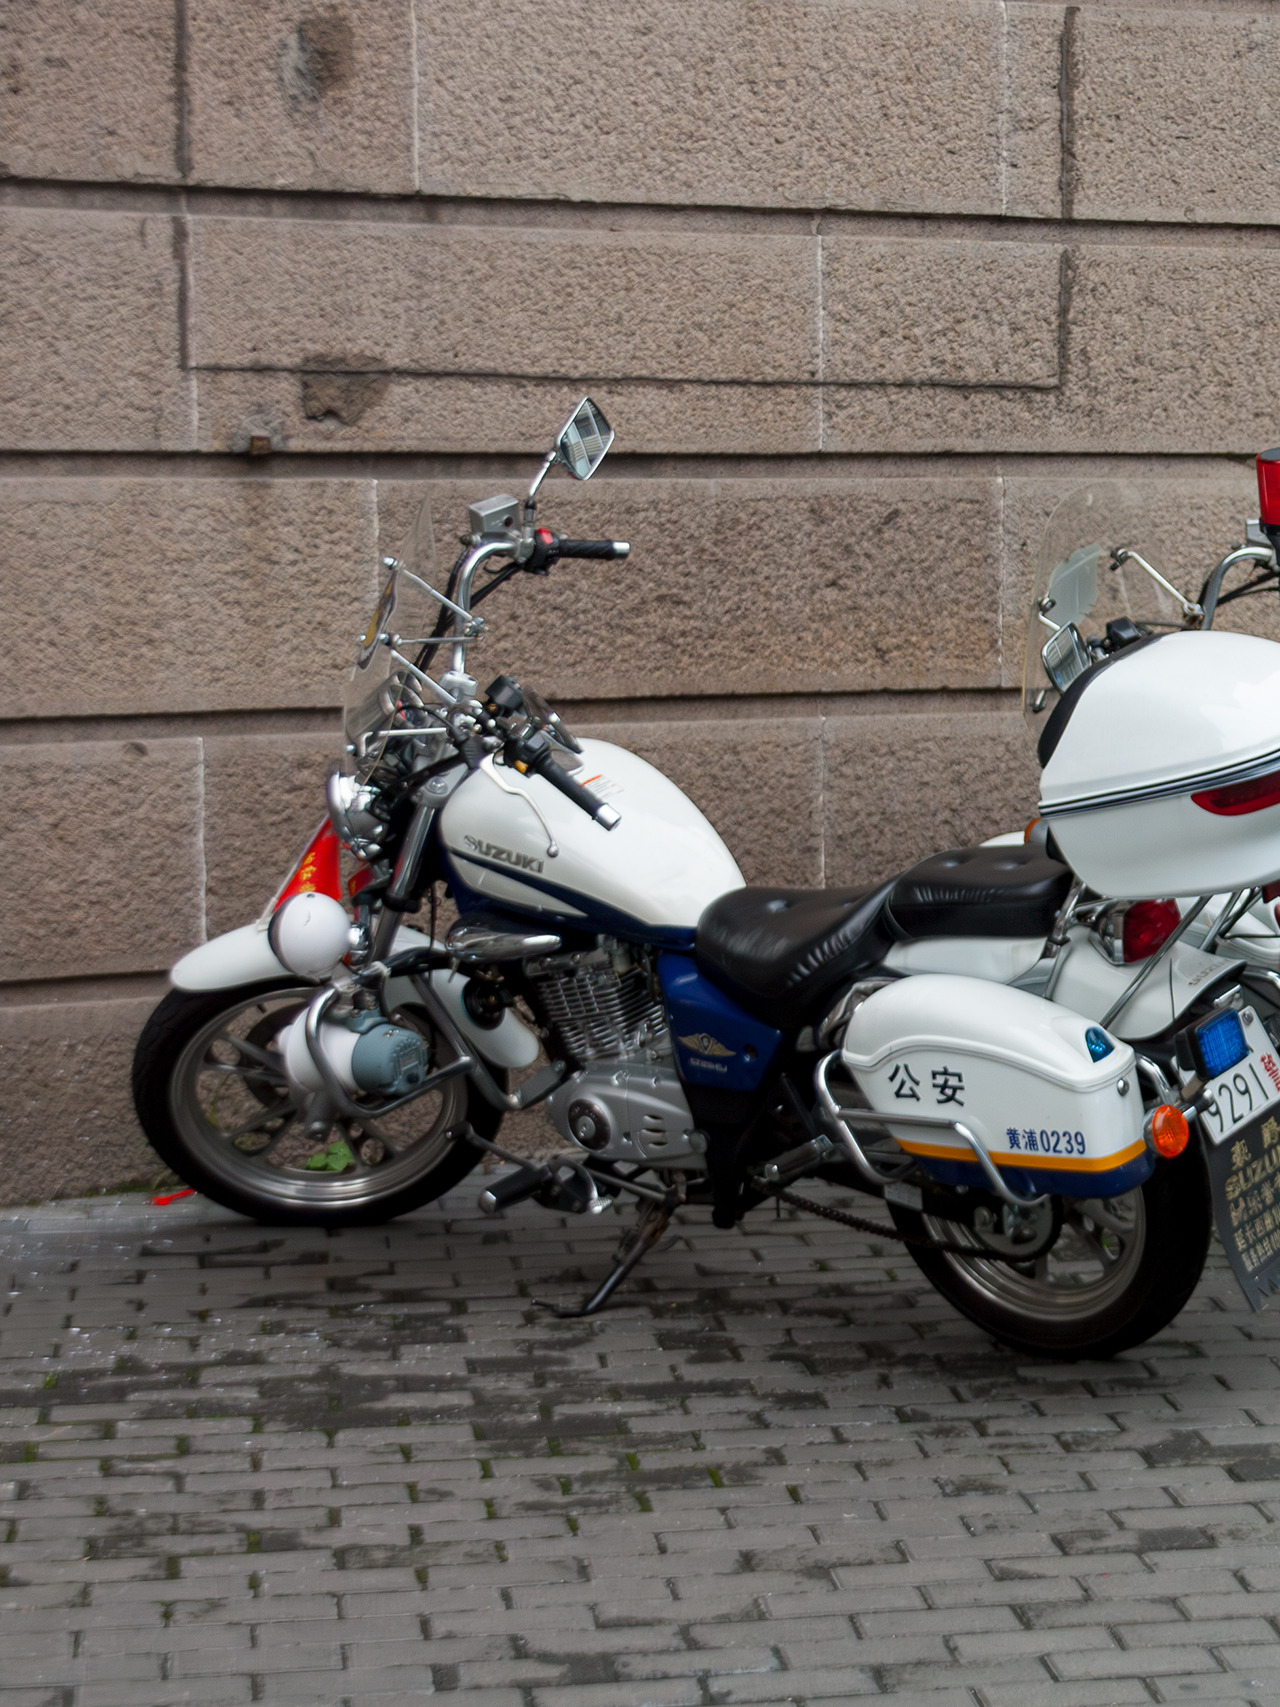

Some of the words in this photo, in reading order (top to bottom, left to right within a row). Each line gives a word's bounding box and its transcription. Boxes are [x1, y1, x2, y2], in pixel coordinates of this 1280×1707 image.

[463, 834, 545, 874] SUZUKI
[888, 1062, 966, 1107] 公安
[1005, 1126, 1087, 1155] 黄浦0239
